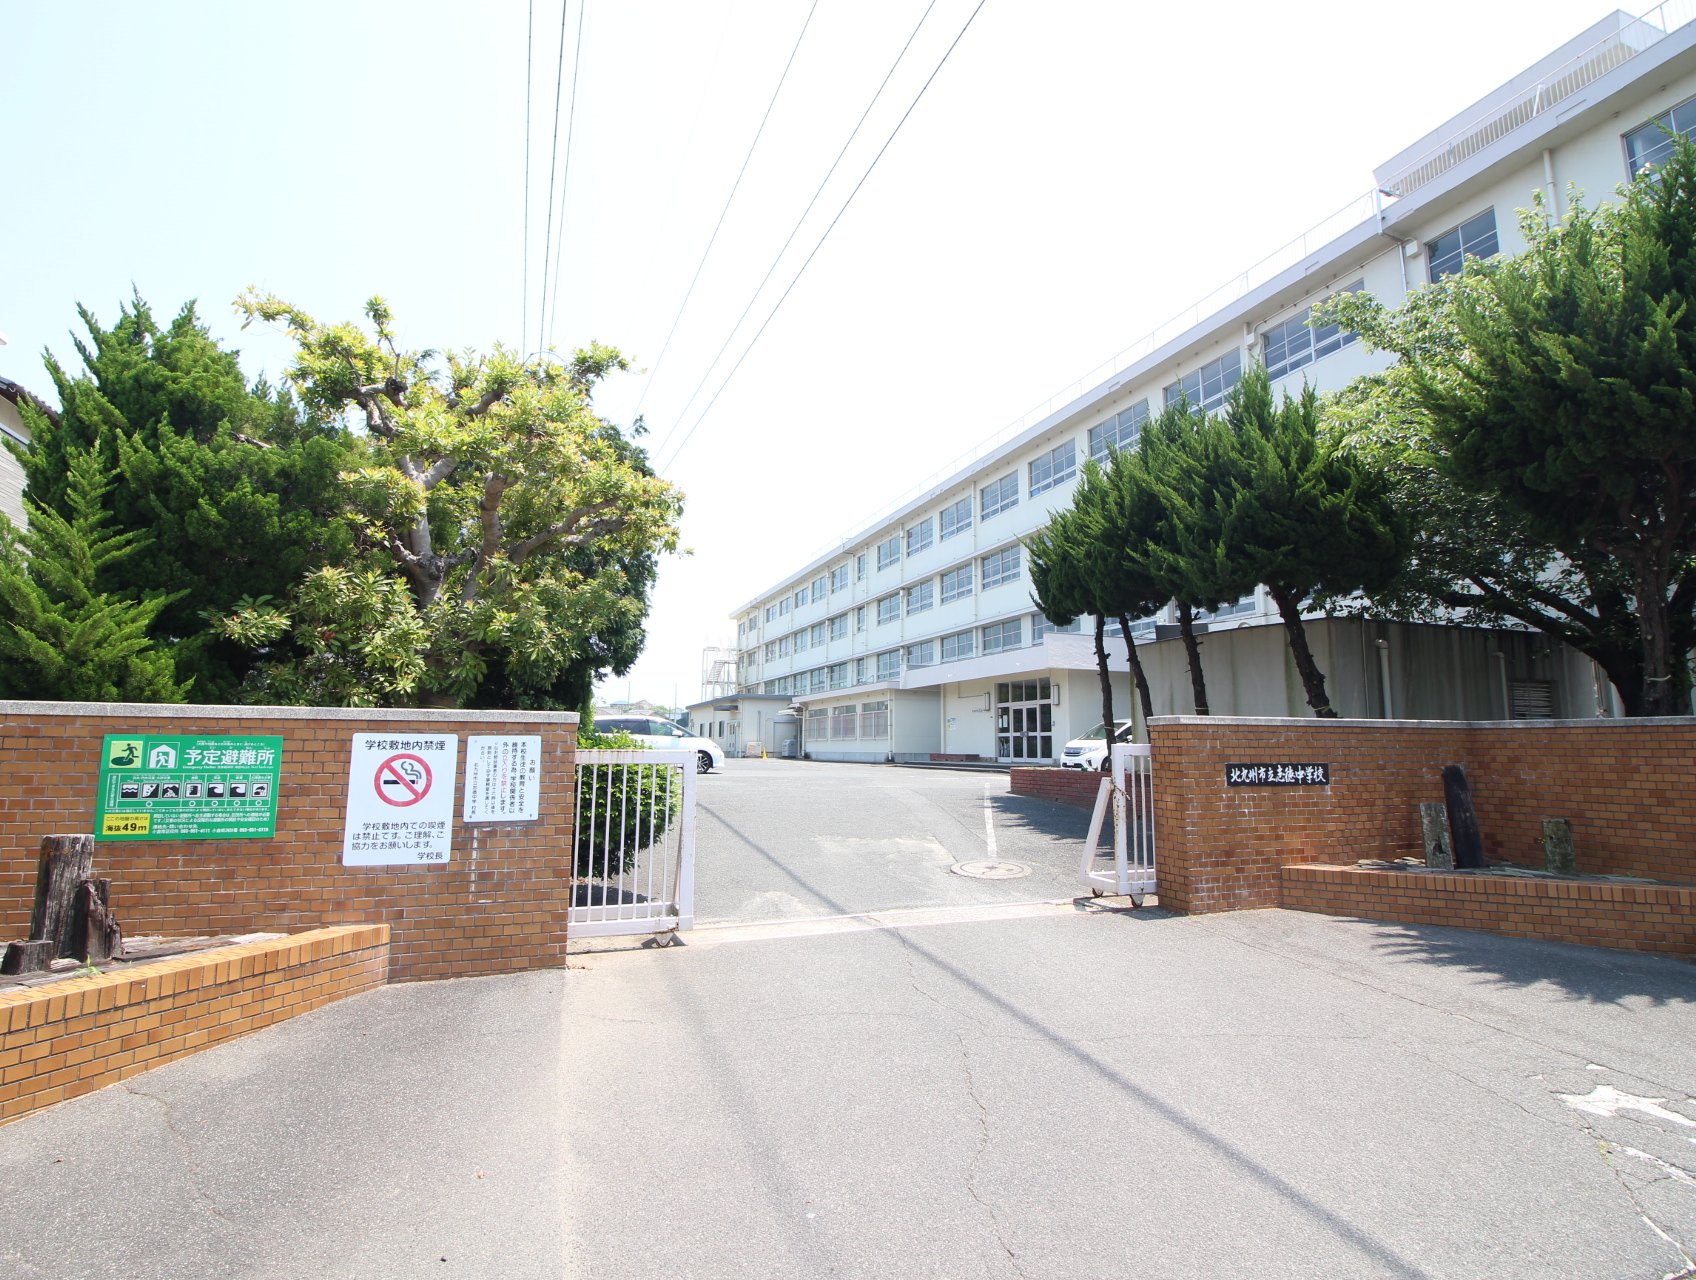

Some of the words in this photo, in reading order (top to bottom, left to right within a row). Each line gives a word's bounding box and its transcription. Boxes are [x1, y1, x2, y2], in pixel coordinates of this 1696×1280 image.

[365, 740, 446, 751] 学校敷地内禁煙
[183, 749, 275, 766] 予定避難所
[528, 759, 536, 781] お願い
[1230, 764, 1327, 784] 北九州市立志徳中学校
[518, 741, 527, 814] 本校生徒の教育と安全を
[105, 822, 147, 832] 海抜49m
[362, 821, 446, 831] 学校敷地内での喫煙
[351, 841, 433, 851] 協力をお願いします。
[417, 851, 443, 860] 学校長
